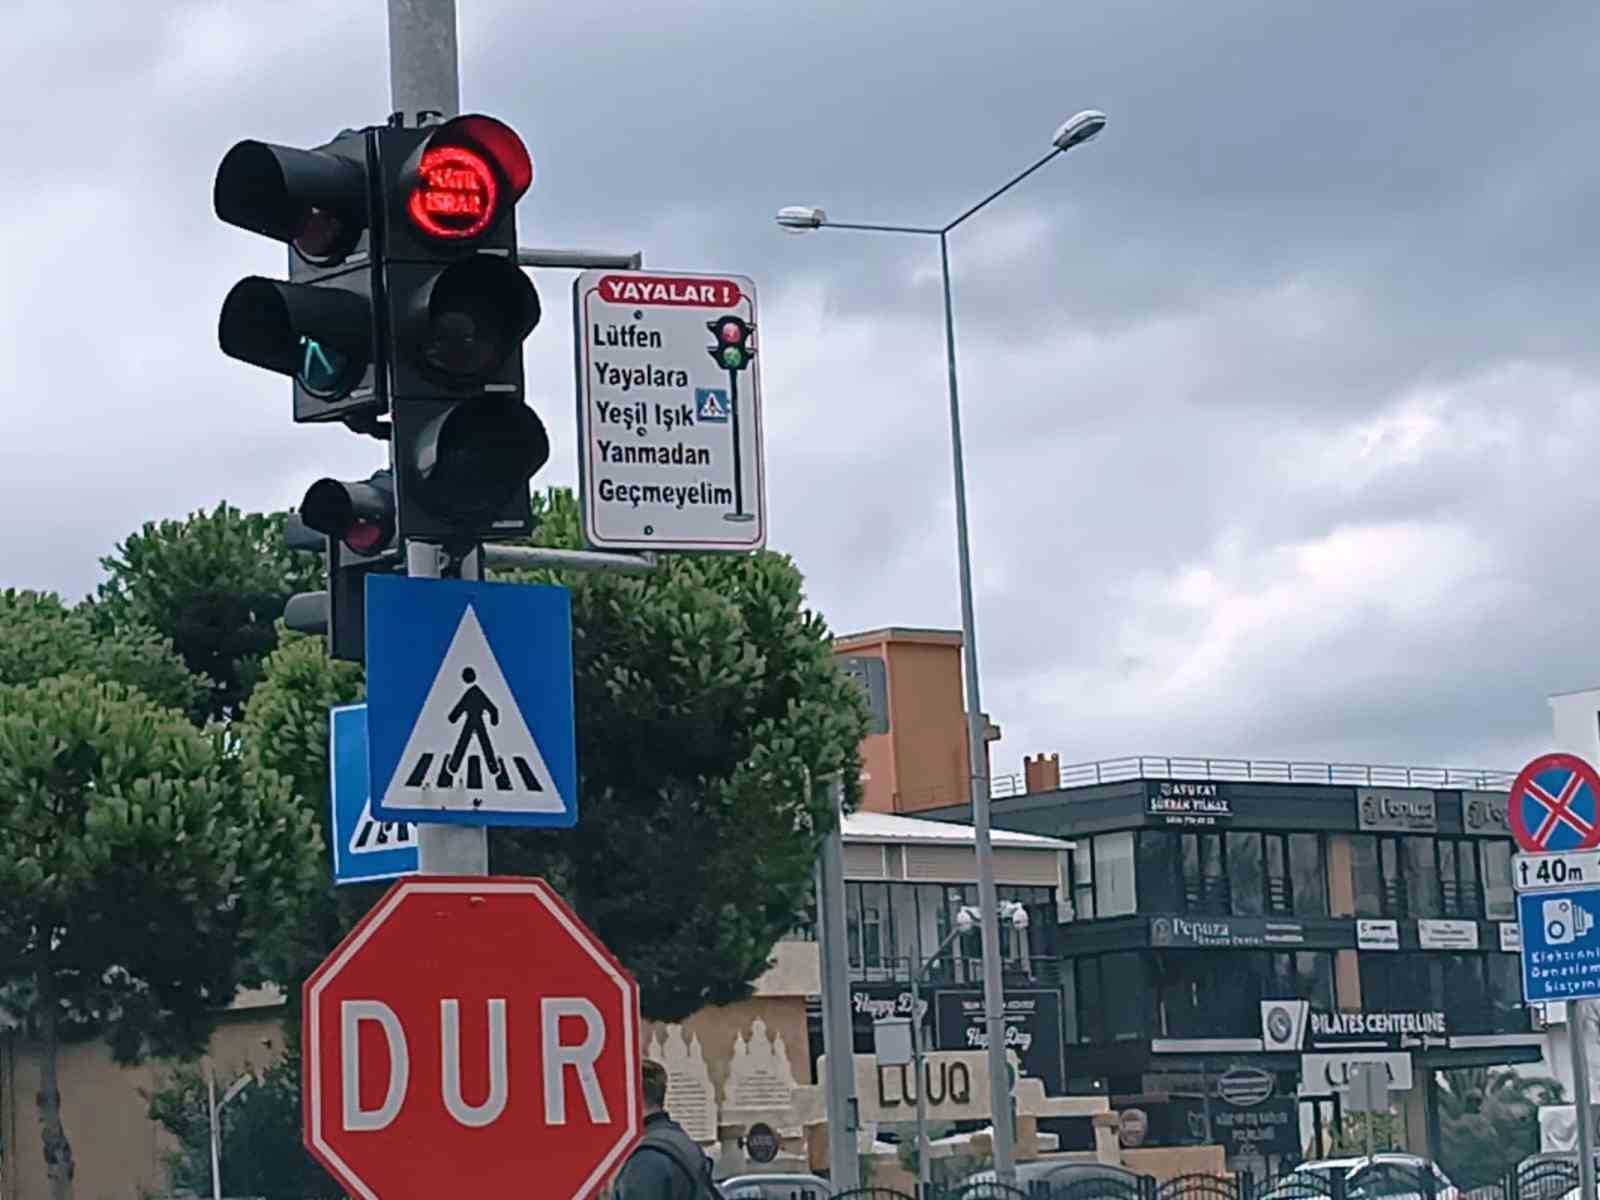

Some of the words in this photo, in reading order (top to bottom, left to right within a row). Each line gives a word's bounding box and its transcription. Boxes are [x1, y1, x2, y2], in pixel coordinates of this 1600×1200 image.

[608, 281, 715, 302] YAYALAR
[594, 323, 662, 348] Lütfen
[595, 362, 689, 391] Yayalara
[597, 401, 647, 430] Yeşil
[656, 403, 694, 431] Işık
[597, 439, 710, 465] Yanmadan
[599, 478, 733, 509] Geçmeyelim
[1531, 947, 1600, 963] Elektroni
[1531, 963, 1600, 978] Denetlem
[1311, 1013, 1364, 1034] PILATES
[341, 997, 611, 1131] DUR
